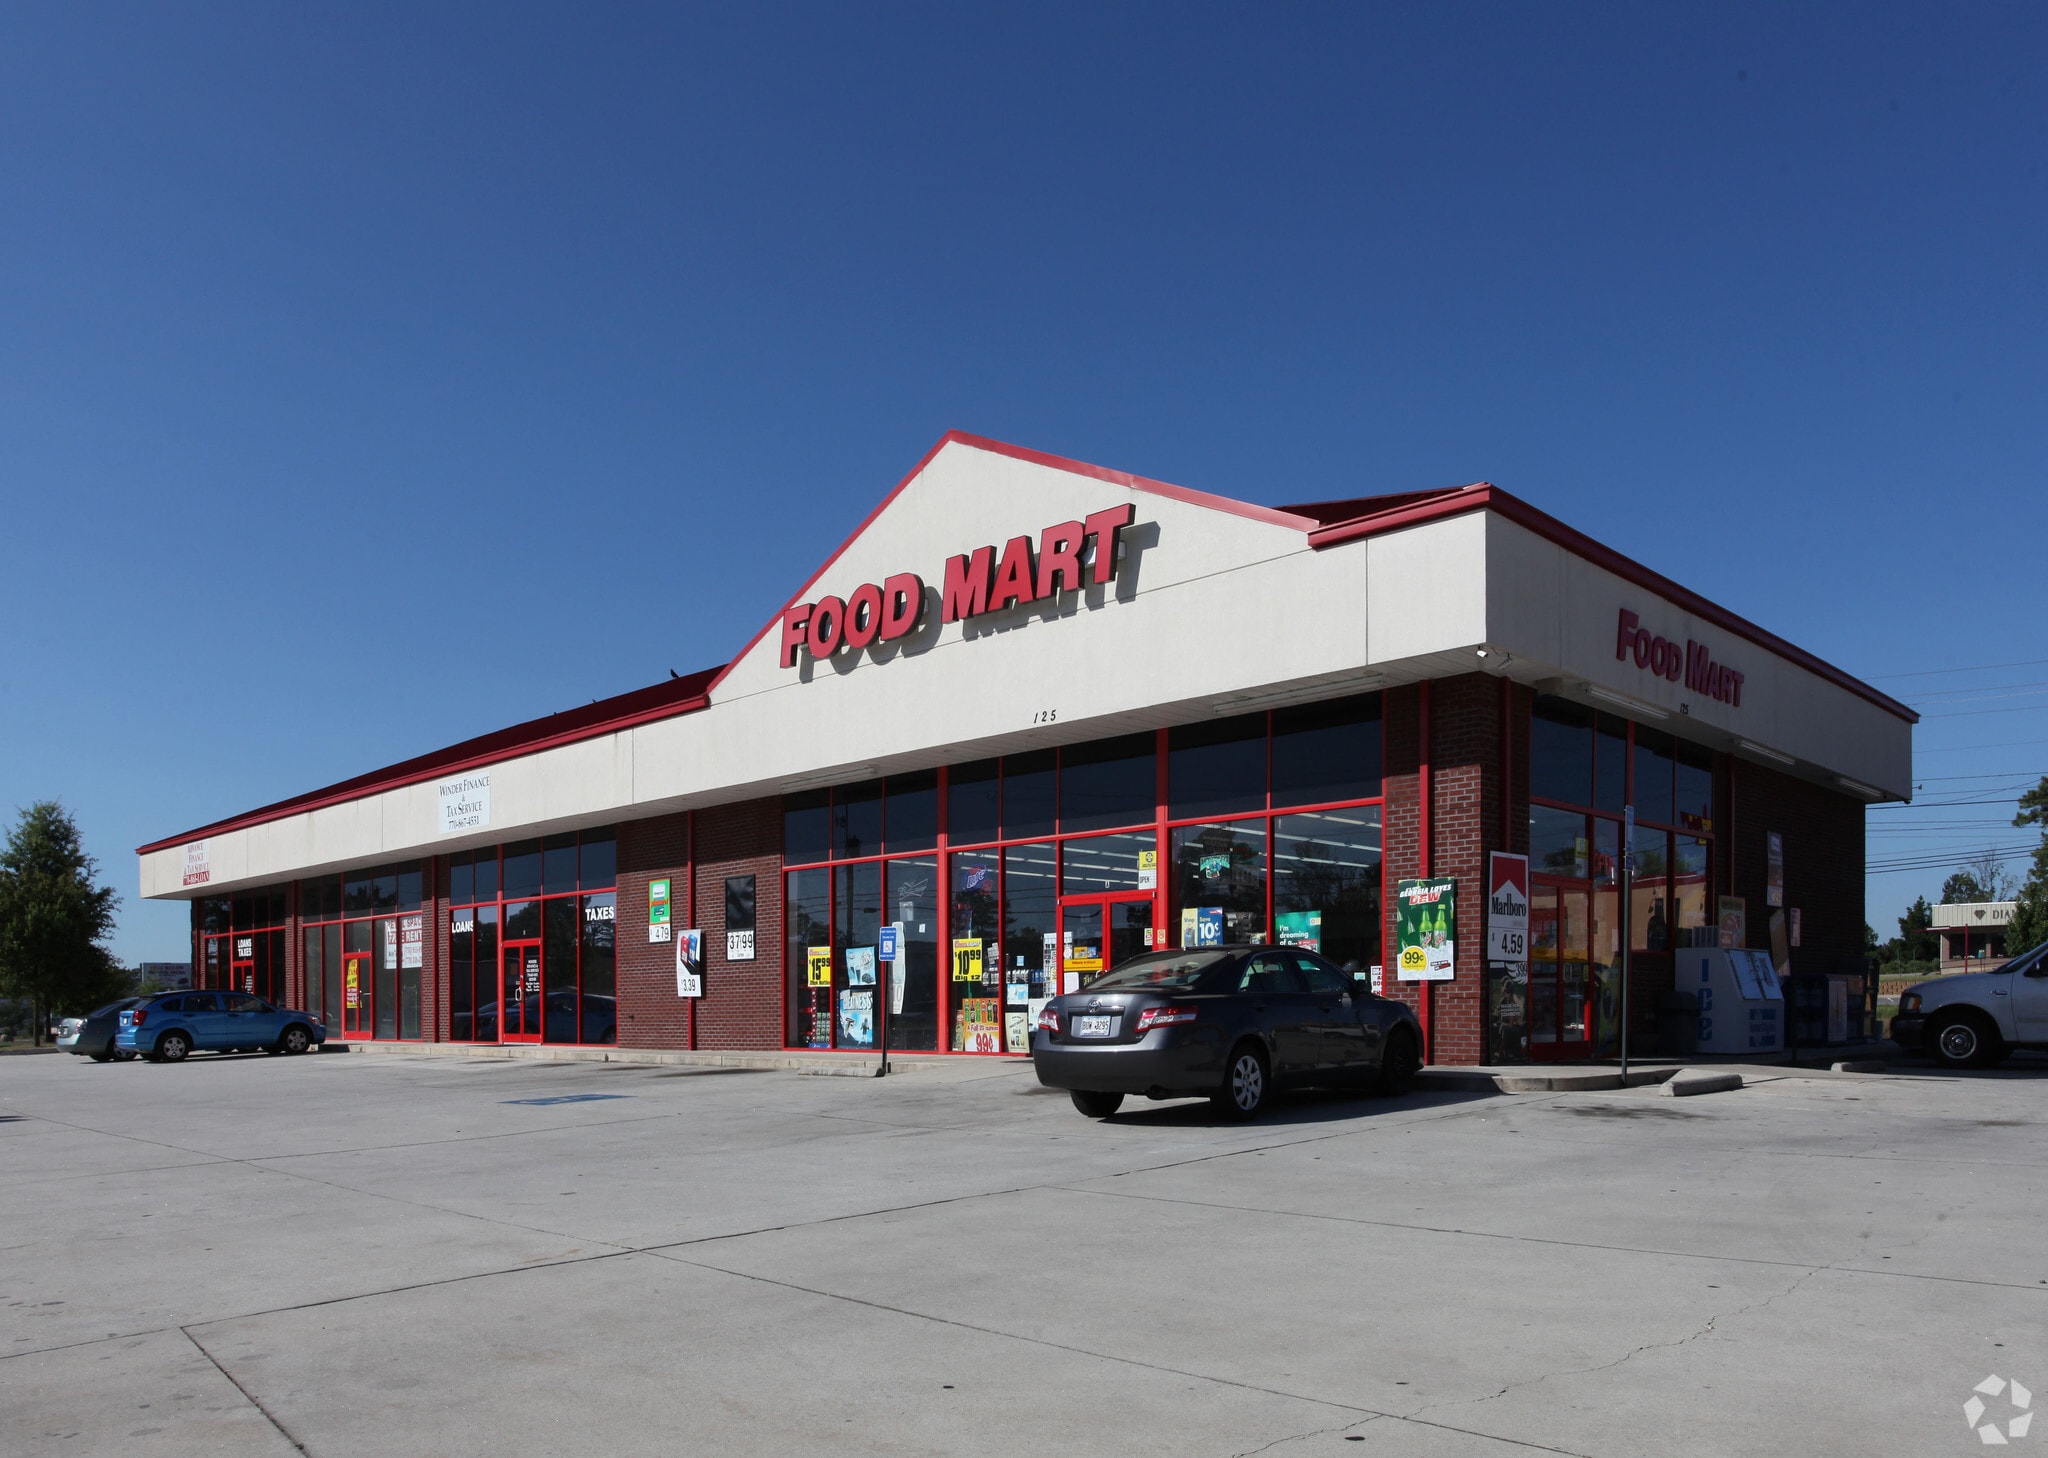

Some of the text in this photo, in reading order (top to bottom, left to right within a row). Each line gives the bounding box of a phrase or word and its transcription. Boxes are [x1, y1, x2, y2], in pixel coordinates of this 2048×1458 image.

[780, 503, 1136, 669] FOOD MART
[1616, 608, 1745, 707] FOOD MART
[1680, 703, 1689, 715] 125
[1033, 709, 1057, 724] 125
[440, 776, 490, 797] WINDER FINANCE
[447, 800, 482, 818] TAX SERVICE
[1400, 885, 1430, 898] GEORGIA
[1409, 891, 1442, 905] DEW
[1491, 893, 1527, 917] Marlboro
[585, 906, 615, 921] TAXES
[451, 920, 474, 934] LOANS
[406, 929, 422, 942] RENT
[1279, 931, 1309, 940] dreaming
[1280, 938, 1287, 946] of
[237, 938, 252, 949] LOANS
[1501, 933, 1524, 955] 4.59
[238, 947, 252, 957] TAXES
[970, 1023, 979, 1032] Full
[976, 1033, 994, 1052] 99¢
